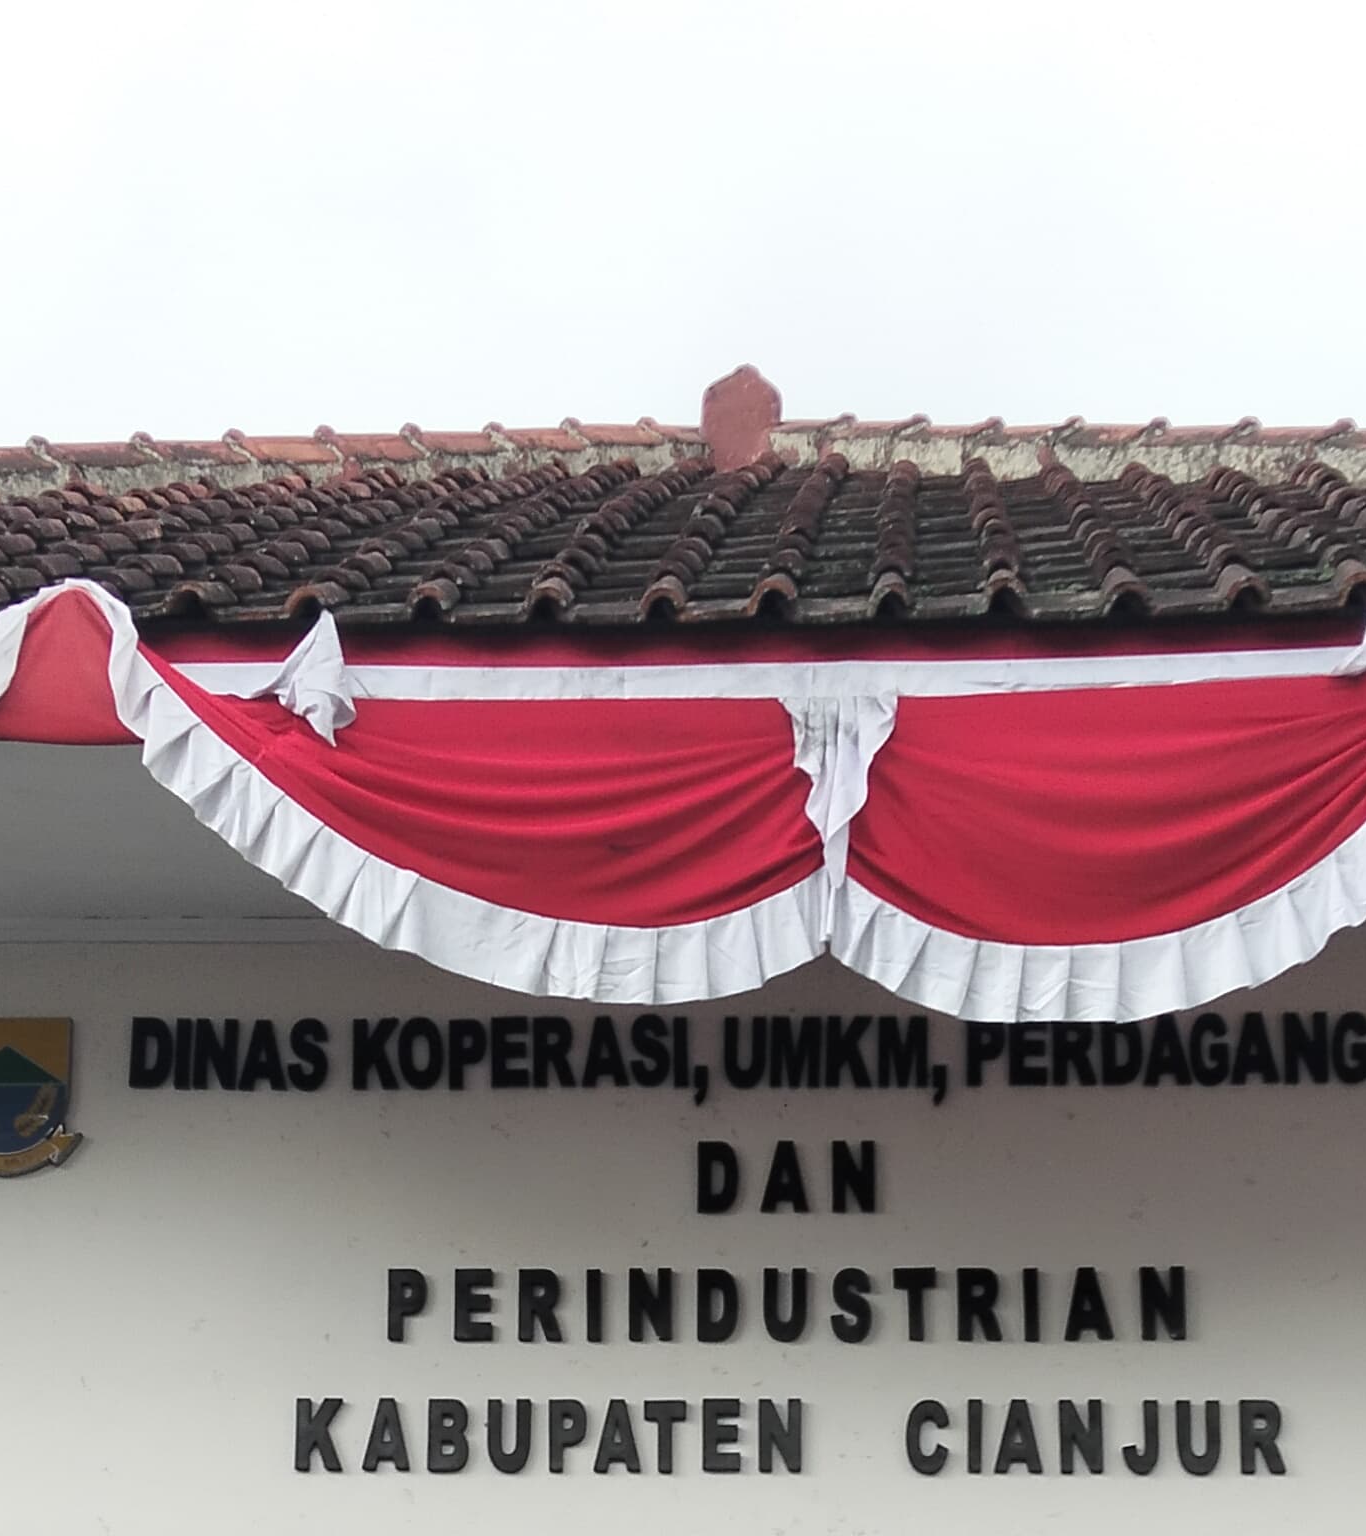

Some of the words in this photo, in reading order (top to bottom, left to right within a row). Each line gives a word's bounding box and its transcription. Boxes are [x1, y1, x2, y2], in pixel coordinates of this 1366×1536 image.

[129, 1017, 330, 1092] DINAS
[352, 1013, 711, 1106] KOPERASI,
[723, 1014, 949, 1106] UMKM,
[697, 1140, 879, 1215] DAN
[388, 1266, 1186, 1343] PERINDUSTRIAN
[296, 1399, 801, 1474] KABUPATEN
[907, 1400, 1285, 1476] CIANJUR
